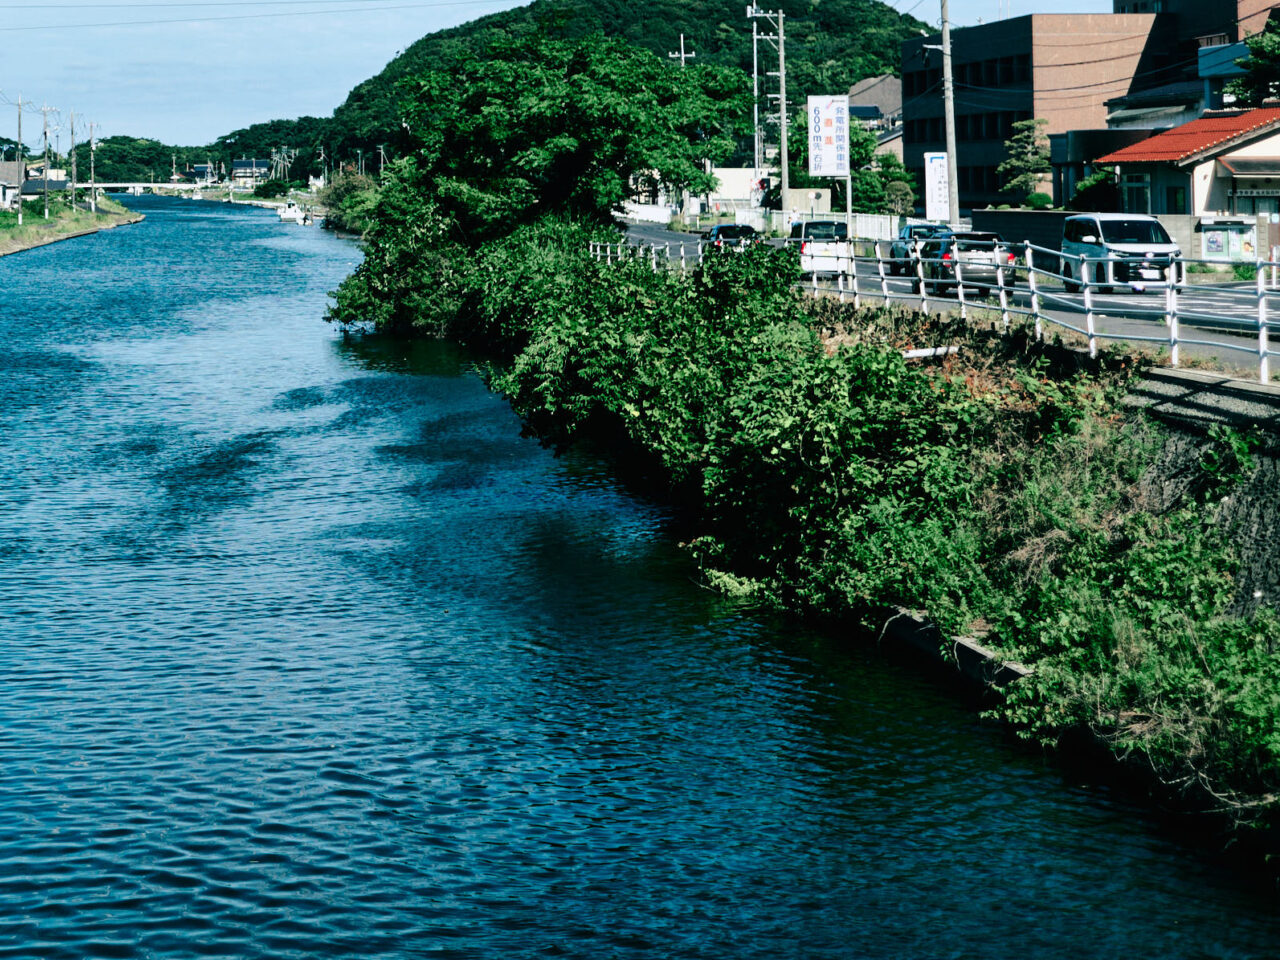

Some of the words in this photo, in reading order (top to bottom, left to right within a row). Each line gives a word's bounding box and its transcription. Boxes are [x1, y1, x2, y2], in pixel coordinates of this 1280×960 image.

[835, 106, 846, 171] 発電所関係車両
